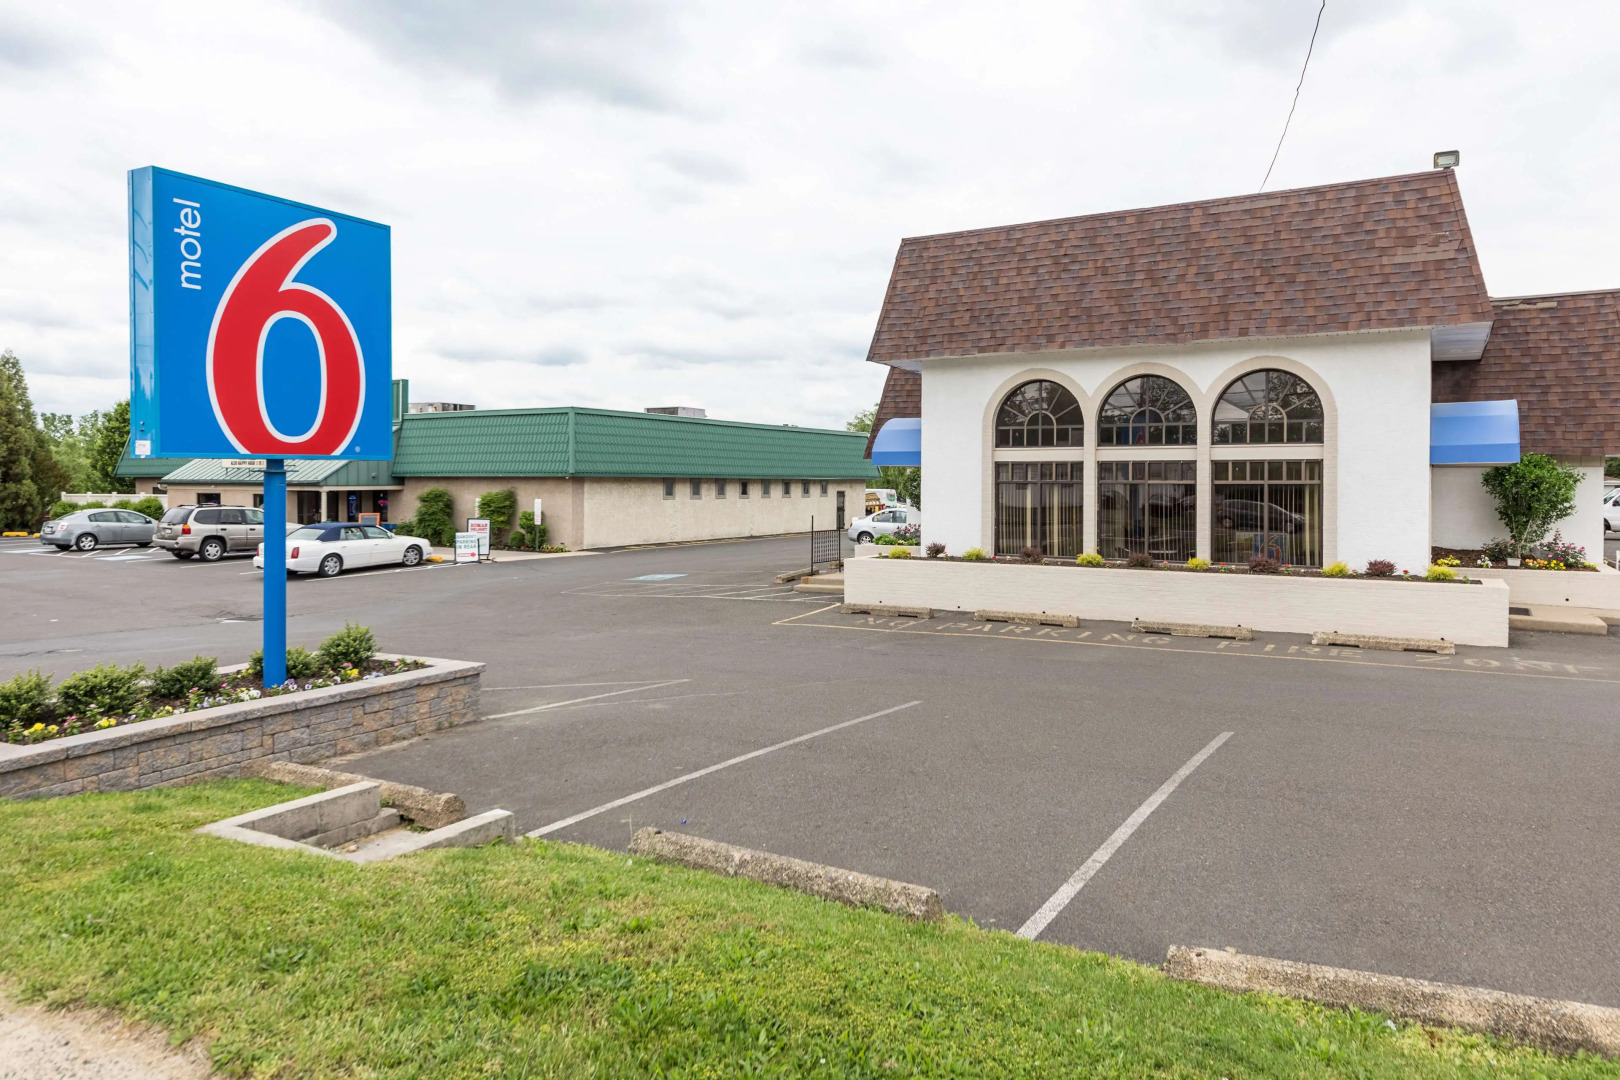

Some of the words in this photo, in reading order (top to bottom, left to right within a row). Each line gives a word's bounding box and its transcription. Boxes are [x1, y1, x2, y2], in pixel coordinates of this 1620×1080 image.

[172, 198, 202, 290] motel
[205, 217, 366, 456] 6
[936, 621, 1172, 645] PARKING
[1216, 641, 1364, 658] FIRE
